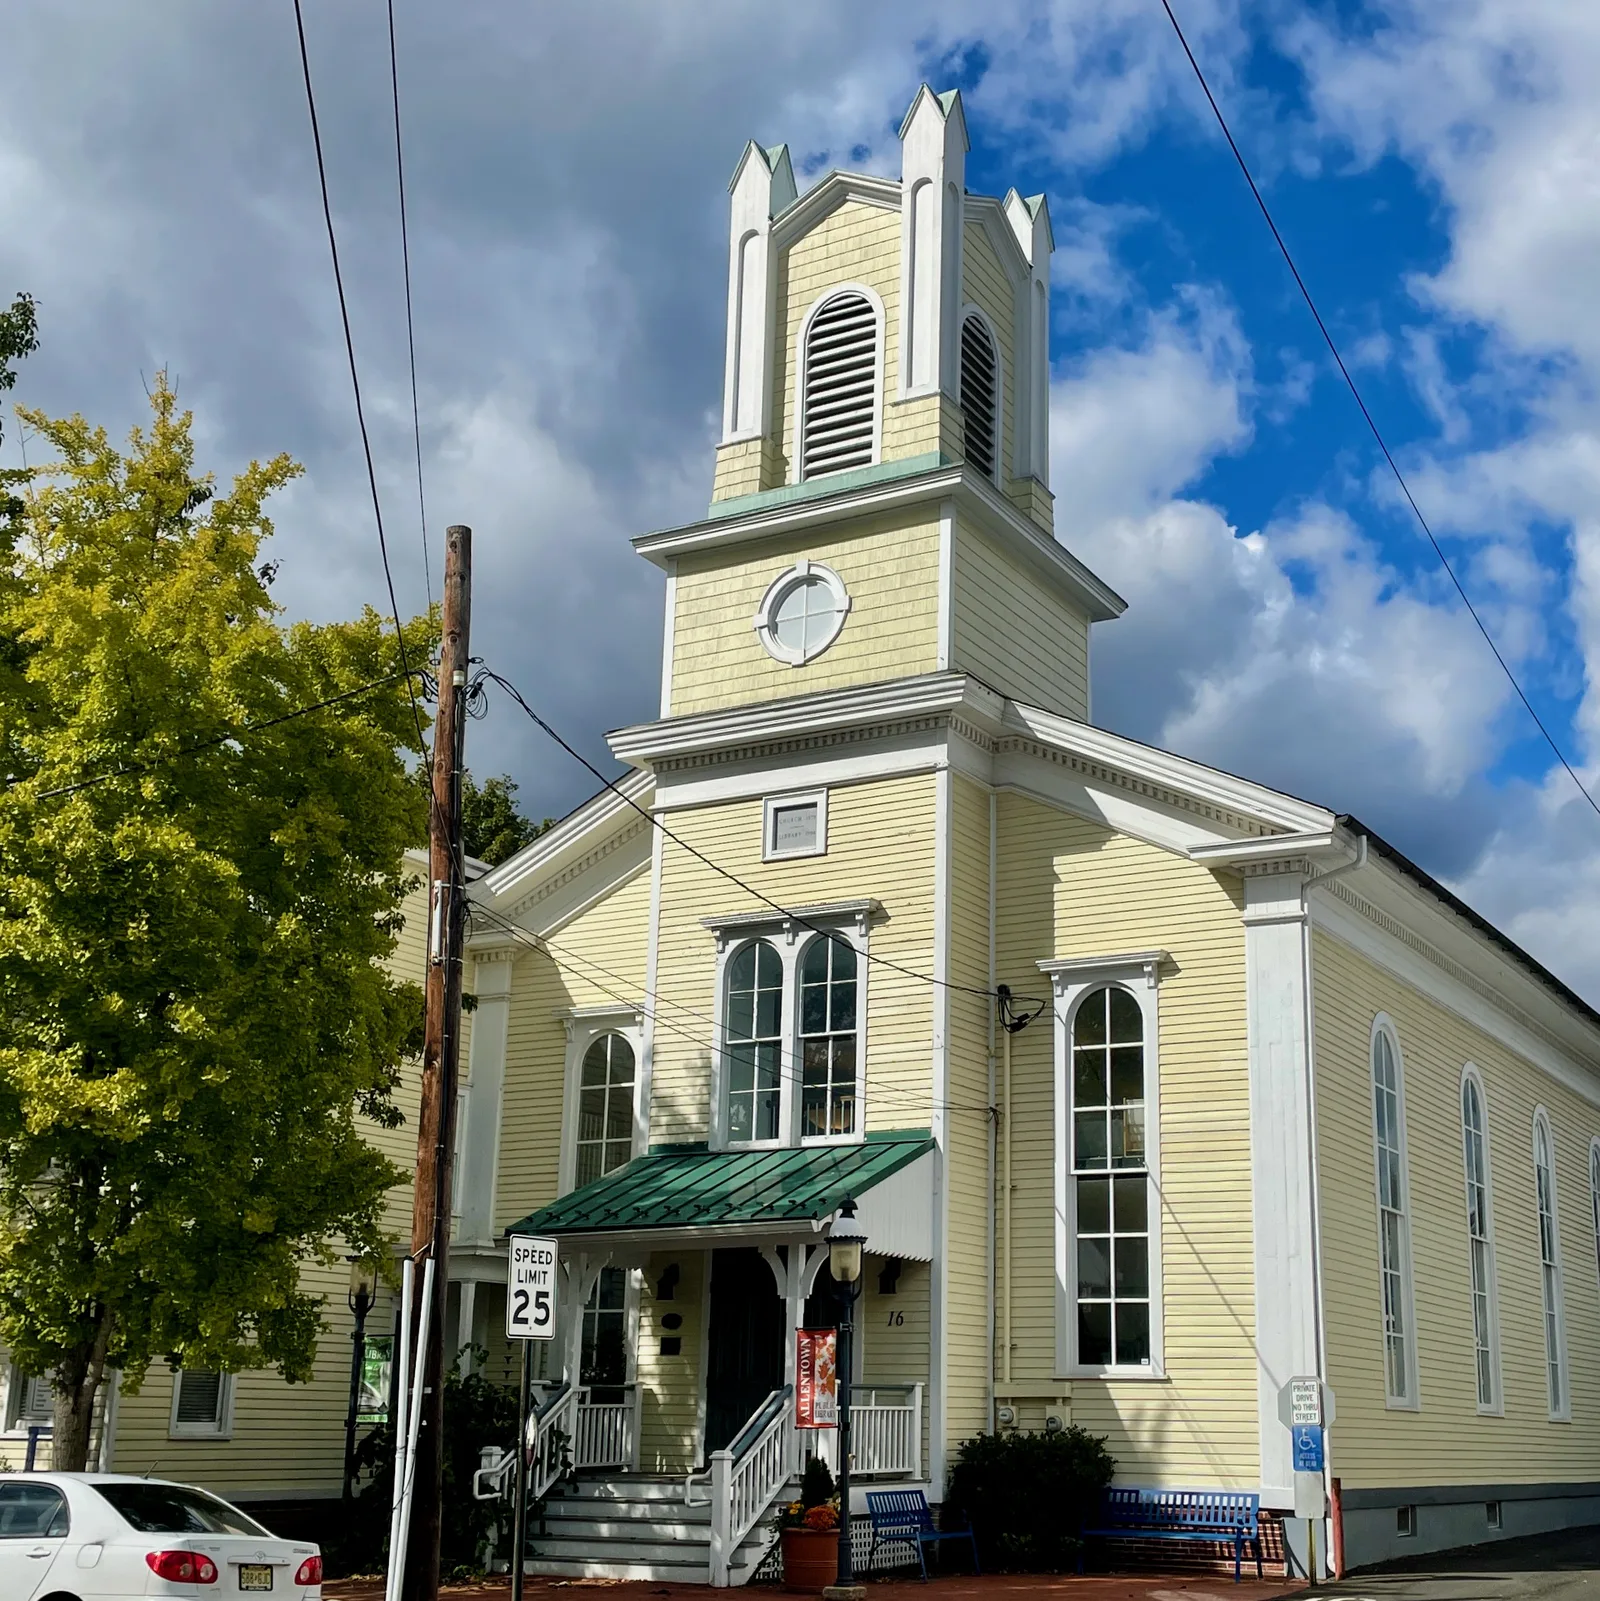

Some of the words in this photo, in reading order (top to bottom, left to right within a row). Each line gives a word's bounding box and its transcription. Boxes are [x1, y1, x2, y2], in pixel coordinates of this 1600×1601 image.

[779, 832, 801, 840] LIBRARY
[515, 1248, 553, 1265] SPEED
[518, 1269, 548, 1285] LIMIT
[513, 1289, 550, 1326] 25
[888, 1311, 904, 1326] 16
[800, 1338, 811, 1419] ALLENTOWN
[1293, 1385, 1315, 1393] PRIVATE
[1296, 1394, 1313, 1402] DRIVE
[1293, 1403, 1301, 1411] NO
[1303, 1403, 1317, 1411] THRU
[1295, 1413, 1316, 1421] STREET
